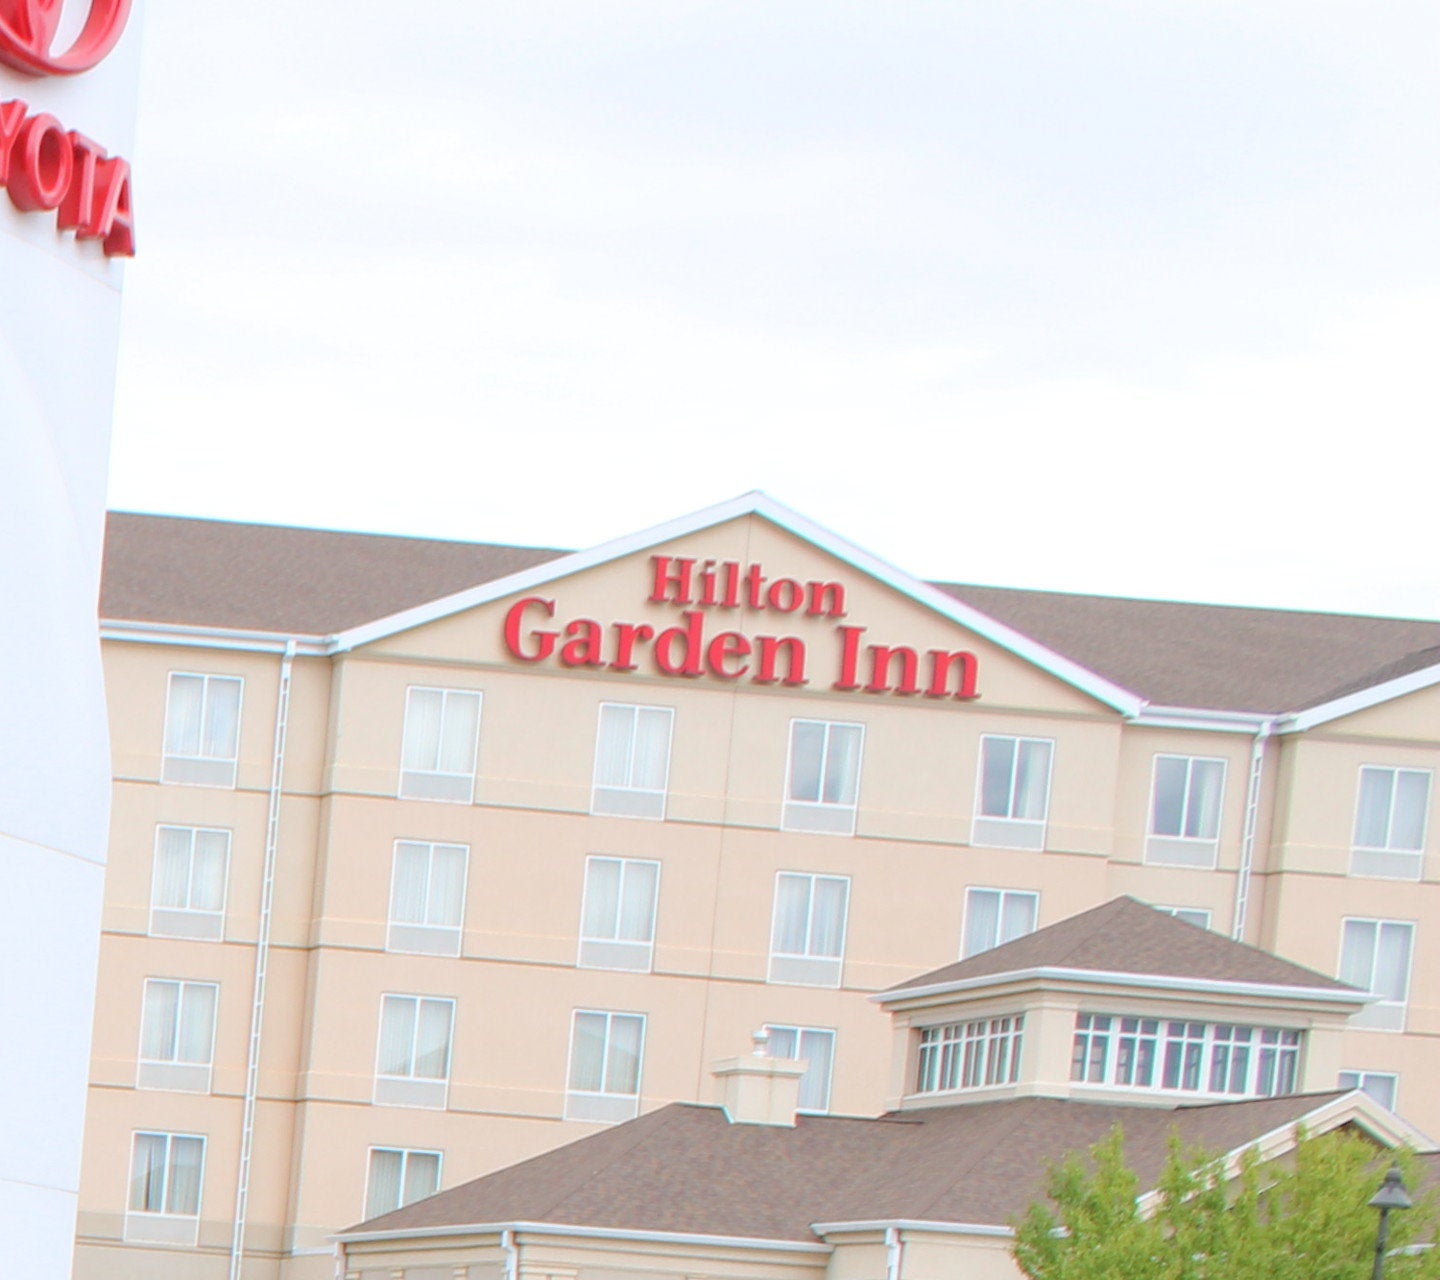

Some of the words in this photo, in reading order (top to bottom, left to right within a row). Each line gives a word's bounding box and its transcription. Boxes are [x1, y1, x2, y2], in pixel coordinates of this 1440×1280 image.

[646, 554, 848, 618] Hilton
[501, 596, 809, 686] Garden
[832, 625, 982, 700] Inn
